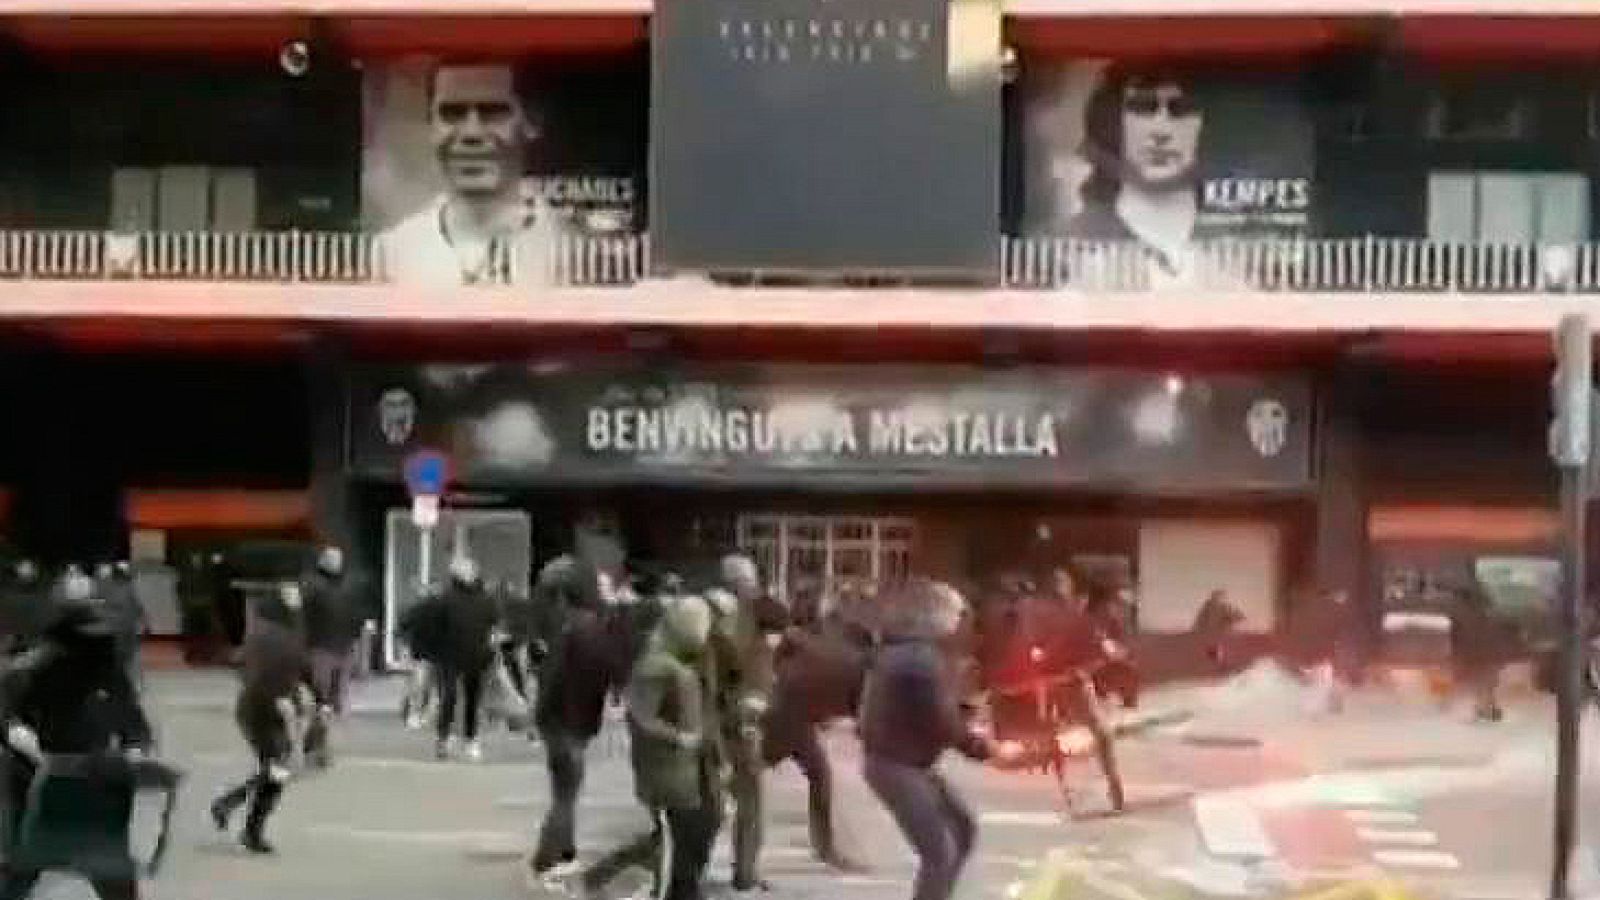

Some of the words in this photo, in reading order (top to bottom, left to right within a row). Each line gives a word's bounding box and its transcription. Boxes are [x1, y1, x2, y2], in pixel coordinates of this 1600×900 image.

[1204, 177, 1308, 209] KEMPES
[831, 409, 859, 454] A
[869, 410, 1058, 457] MESTALLA
